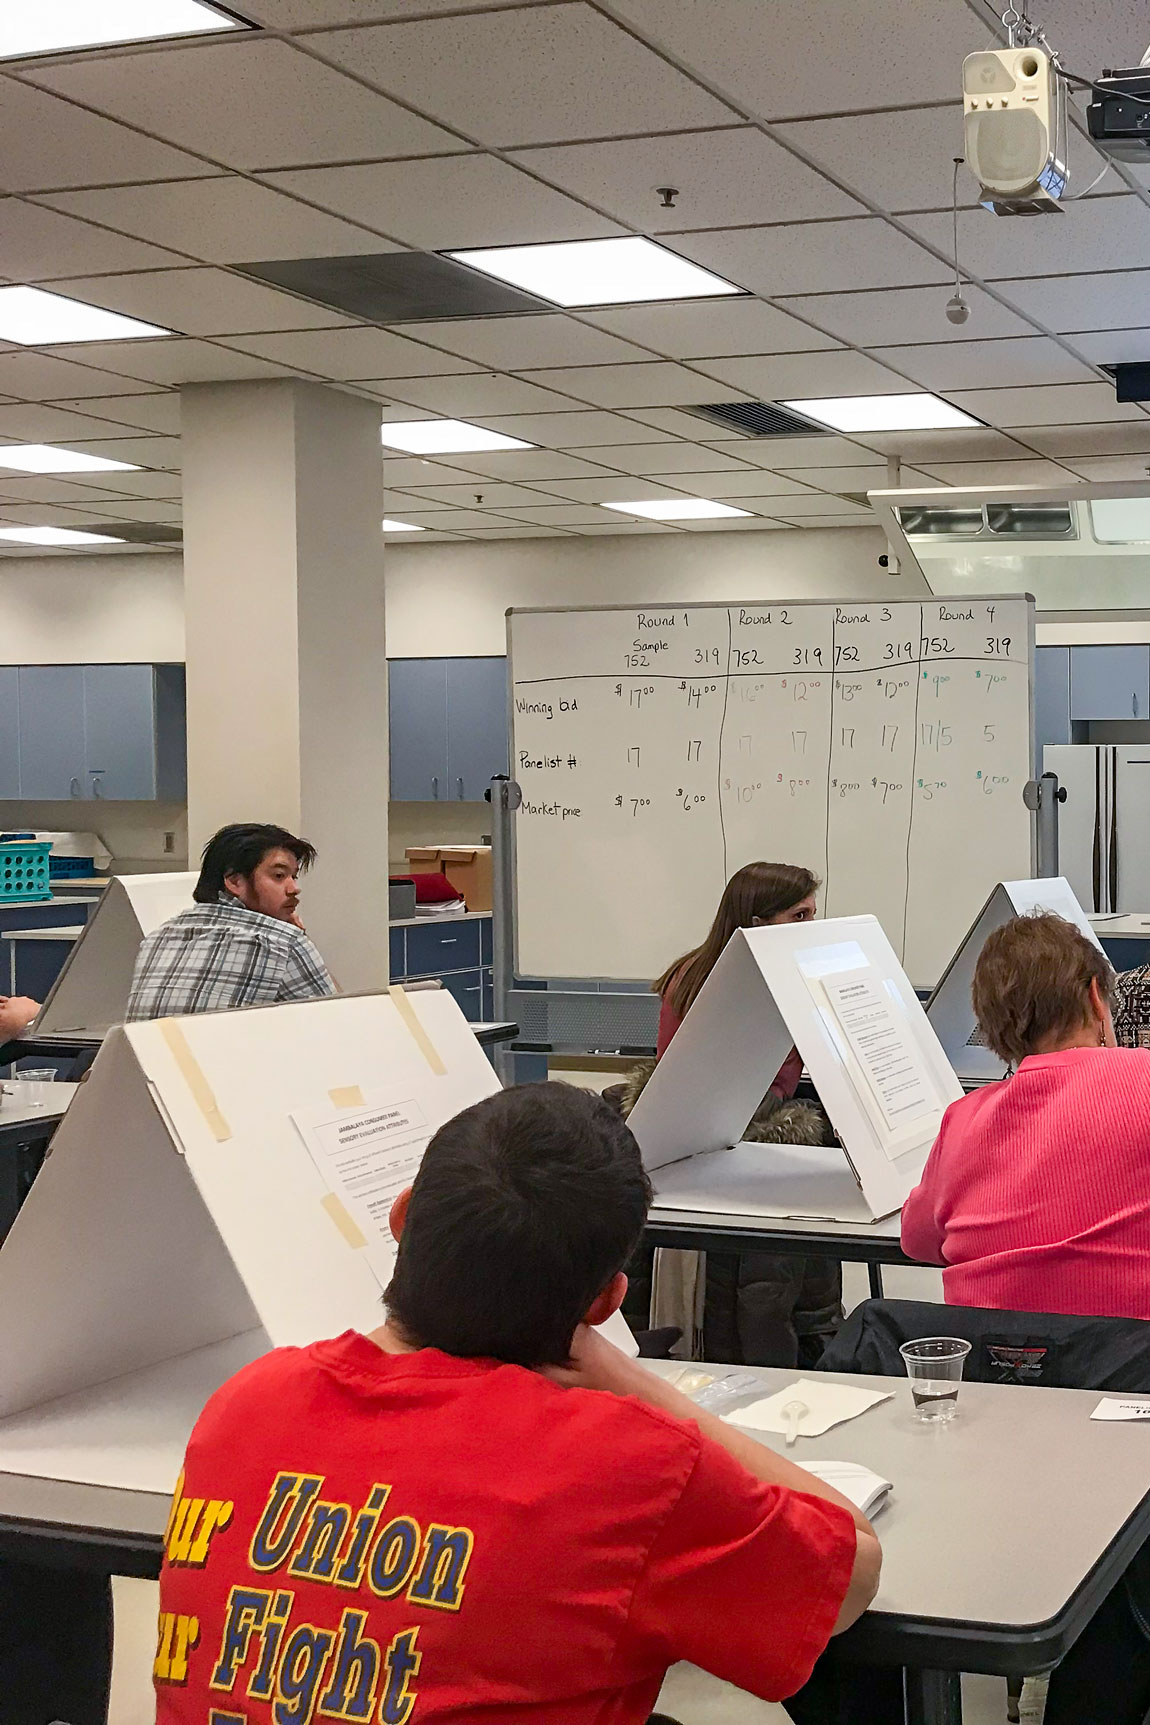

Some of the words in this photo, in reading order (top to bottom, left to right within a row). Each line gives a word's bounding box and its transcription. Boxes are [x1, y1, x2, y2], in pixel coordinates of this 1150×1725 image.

[637, 613, 676, 627] Round
[739, 609, 772, 625] Round
[780, 610, 793, 625] 2
[835, 608, 870, 624] Round
[880, 608, 892, 622] 3
[939, 606, 974, 621] Round
[986, 606, 996, 623] 4
[633, 639, 669, 653] Sample
[835, 646, 860, 666] 752
[883, 641, 913, 660] 319
[921, 637, 956, 655] 752
[983, 637, 1012, 656] 319
[624, 654, 650, 667] 752
[694, 648, 720, 666] 319
[732, 650, 764, 667] 752
[793, 648, 823, 666] 319
[516, 699, 553, 720] Winning
[792, 731, 807, 754] 17
[841, 727, 855, 748] 17
[881, 724, 899, 752] 17
[983, 724, 996, 742] 5
[519, 750, 563, 769] Panelist
[627, 747, 640, 768] 17
[688, 740, 702, 762] 17
[521, 800, 561, 816] Market
[249, 1470, 475, 1611] Union
[209, 1584, 423, 1725] Fight
